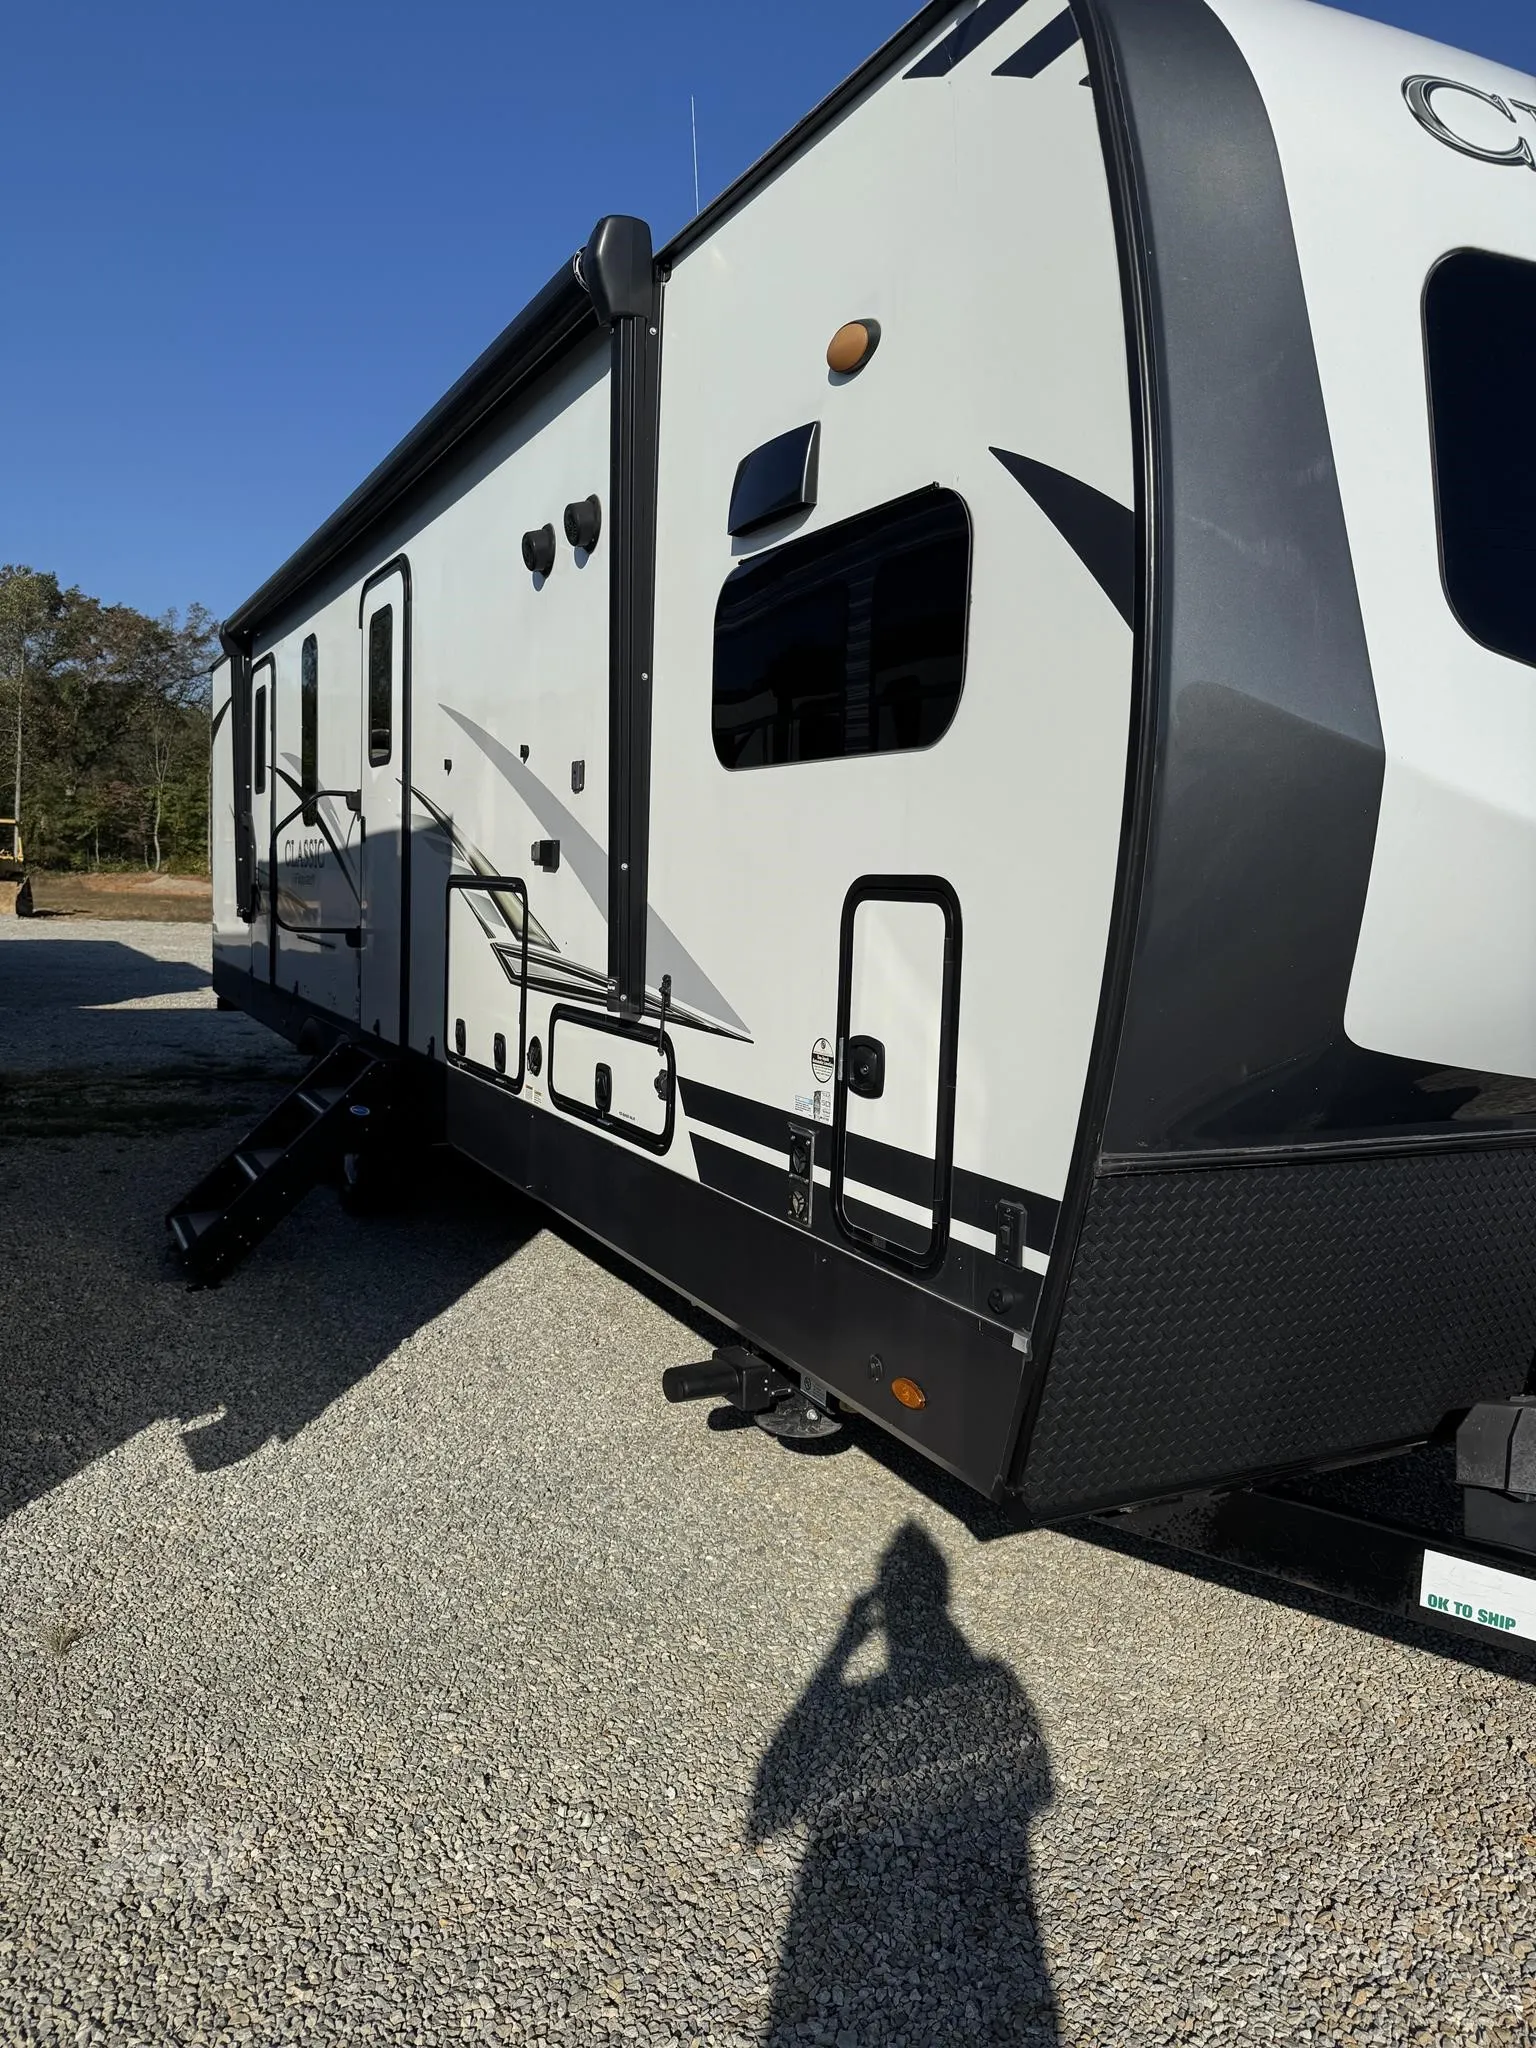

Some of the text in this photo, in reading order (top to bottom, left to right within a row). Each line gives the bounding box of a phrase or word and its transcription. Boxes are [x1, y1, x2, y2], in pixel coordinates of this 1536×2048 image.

[1400, 74, 1536, 172] C
[285, 838, 326, 869] CLASSIC
[1427, 1593, 1517, 1631] OK TO SHIP
